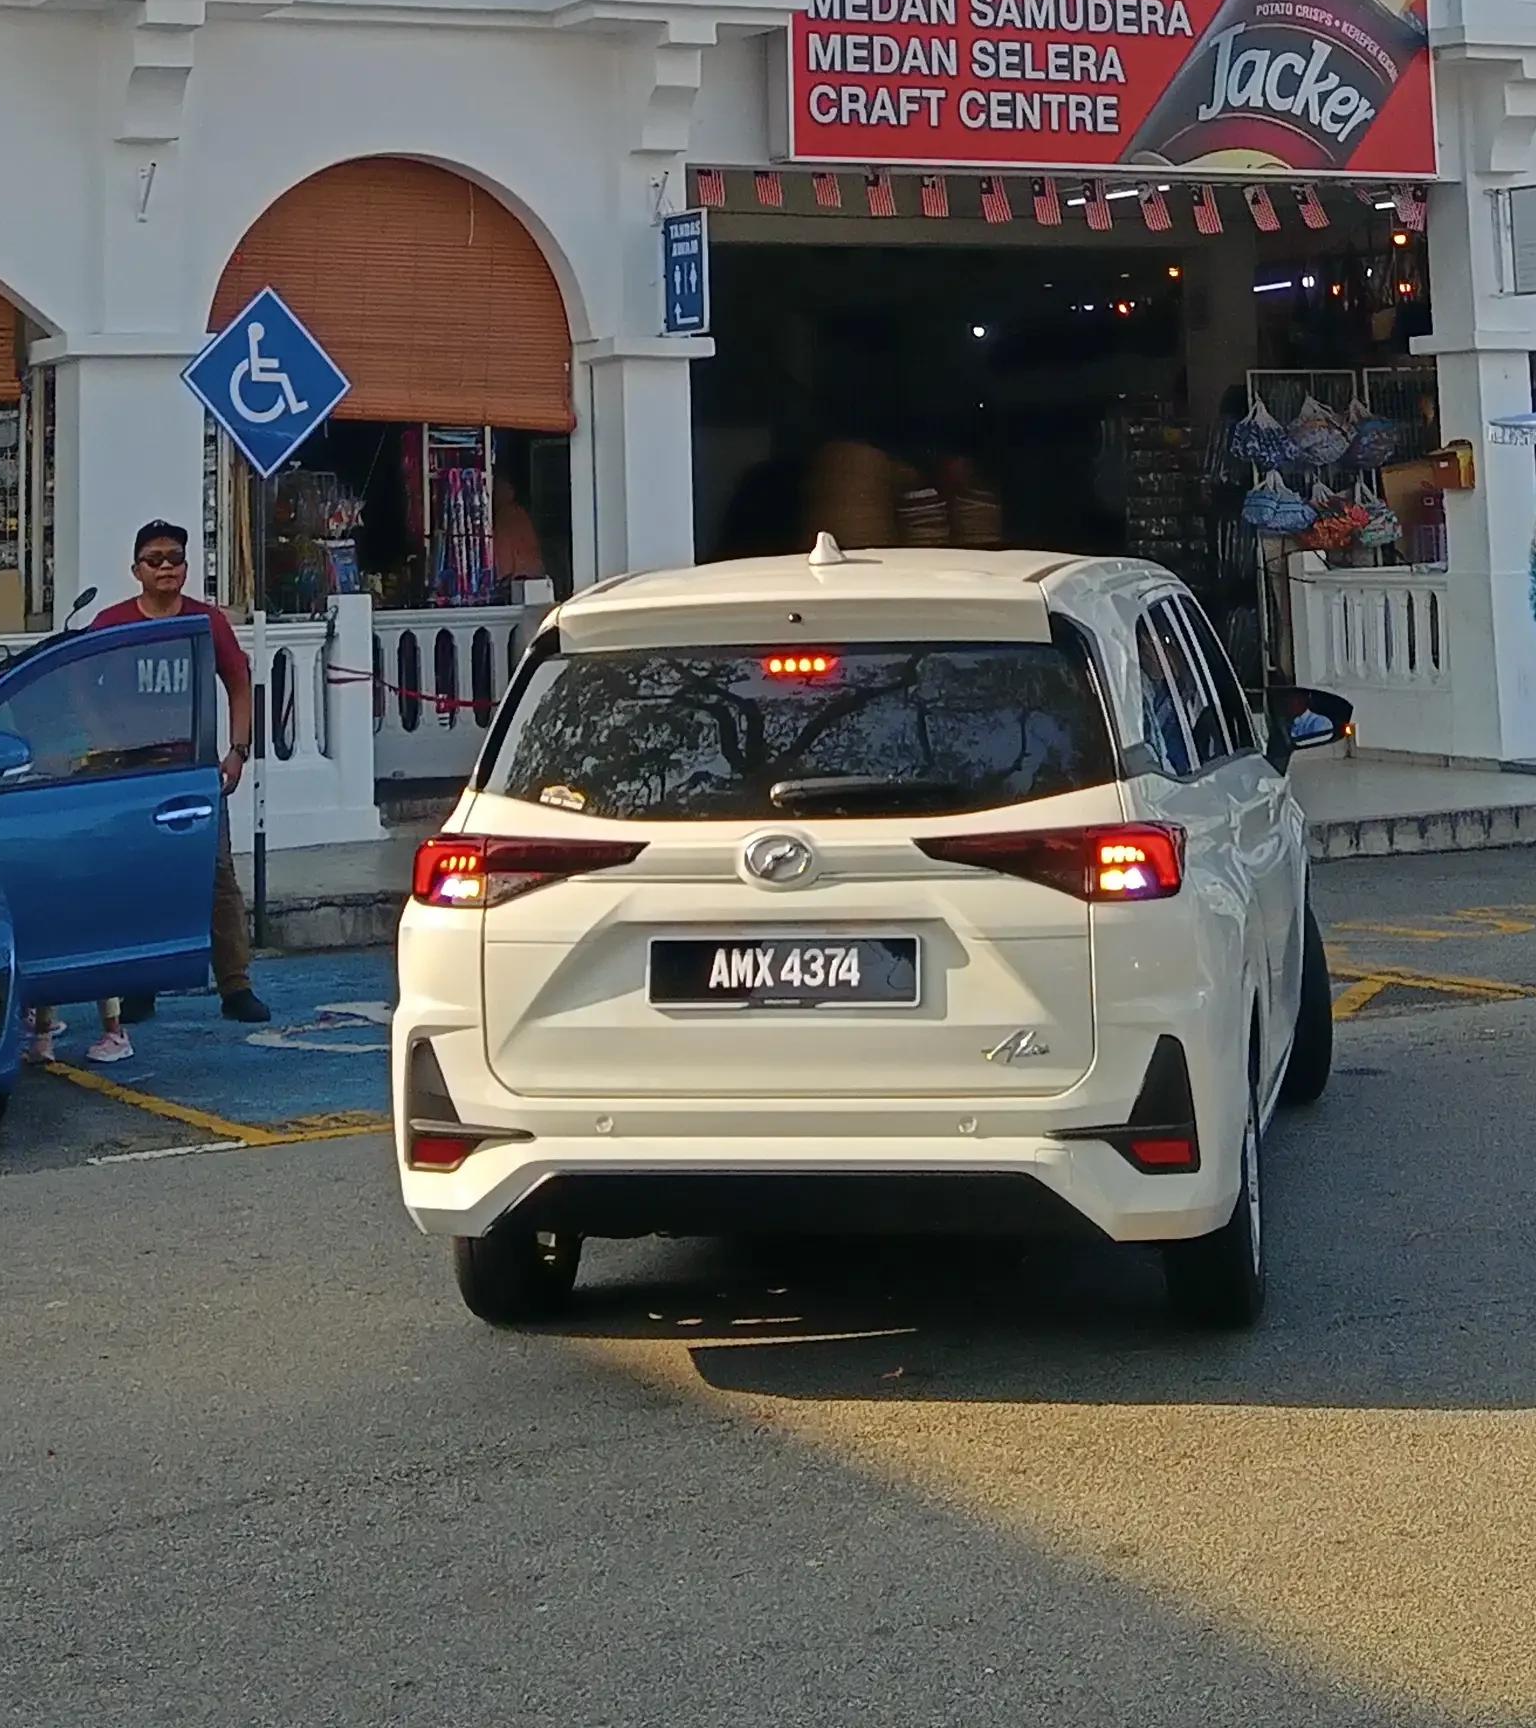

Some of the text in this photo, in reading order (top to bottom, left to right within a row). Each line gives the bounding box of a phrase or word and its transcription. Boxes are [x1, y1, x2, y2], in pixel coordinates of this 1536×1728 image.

[1256, 2, 1293, 17] POTATO
[1295, 4, 1334, 27] CRISPS
[807, 33, 1127, 85] MEDAN SELERA
[1198, 22, 1377, 143] Jacker
[808, 83, 1121, 136] CRAFT CENTRE
[669, 219, 701, 240] TANDAS
[708, 948, 861, 989] AMX 4374
